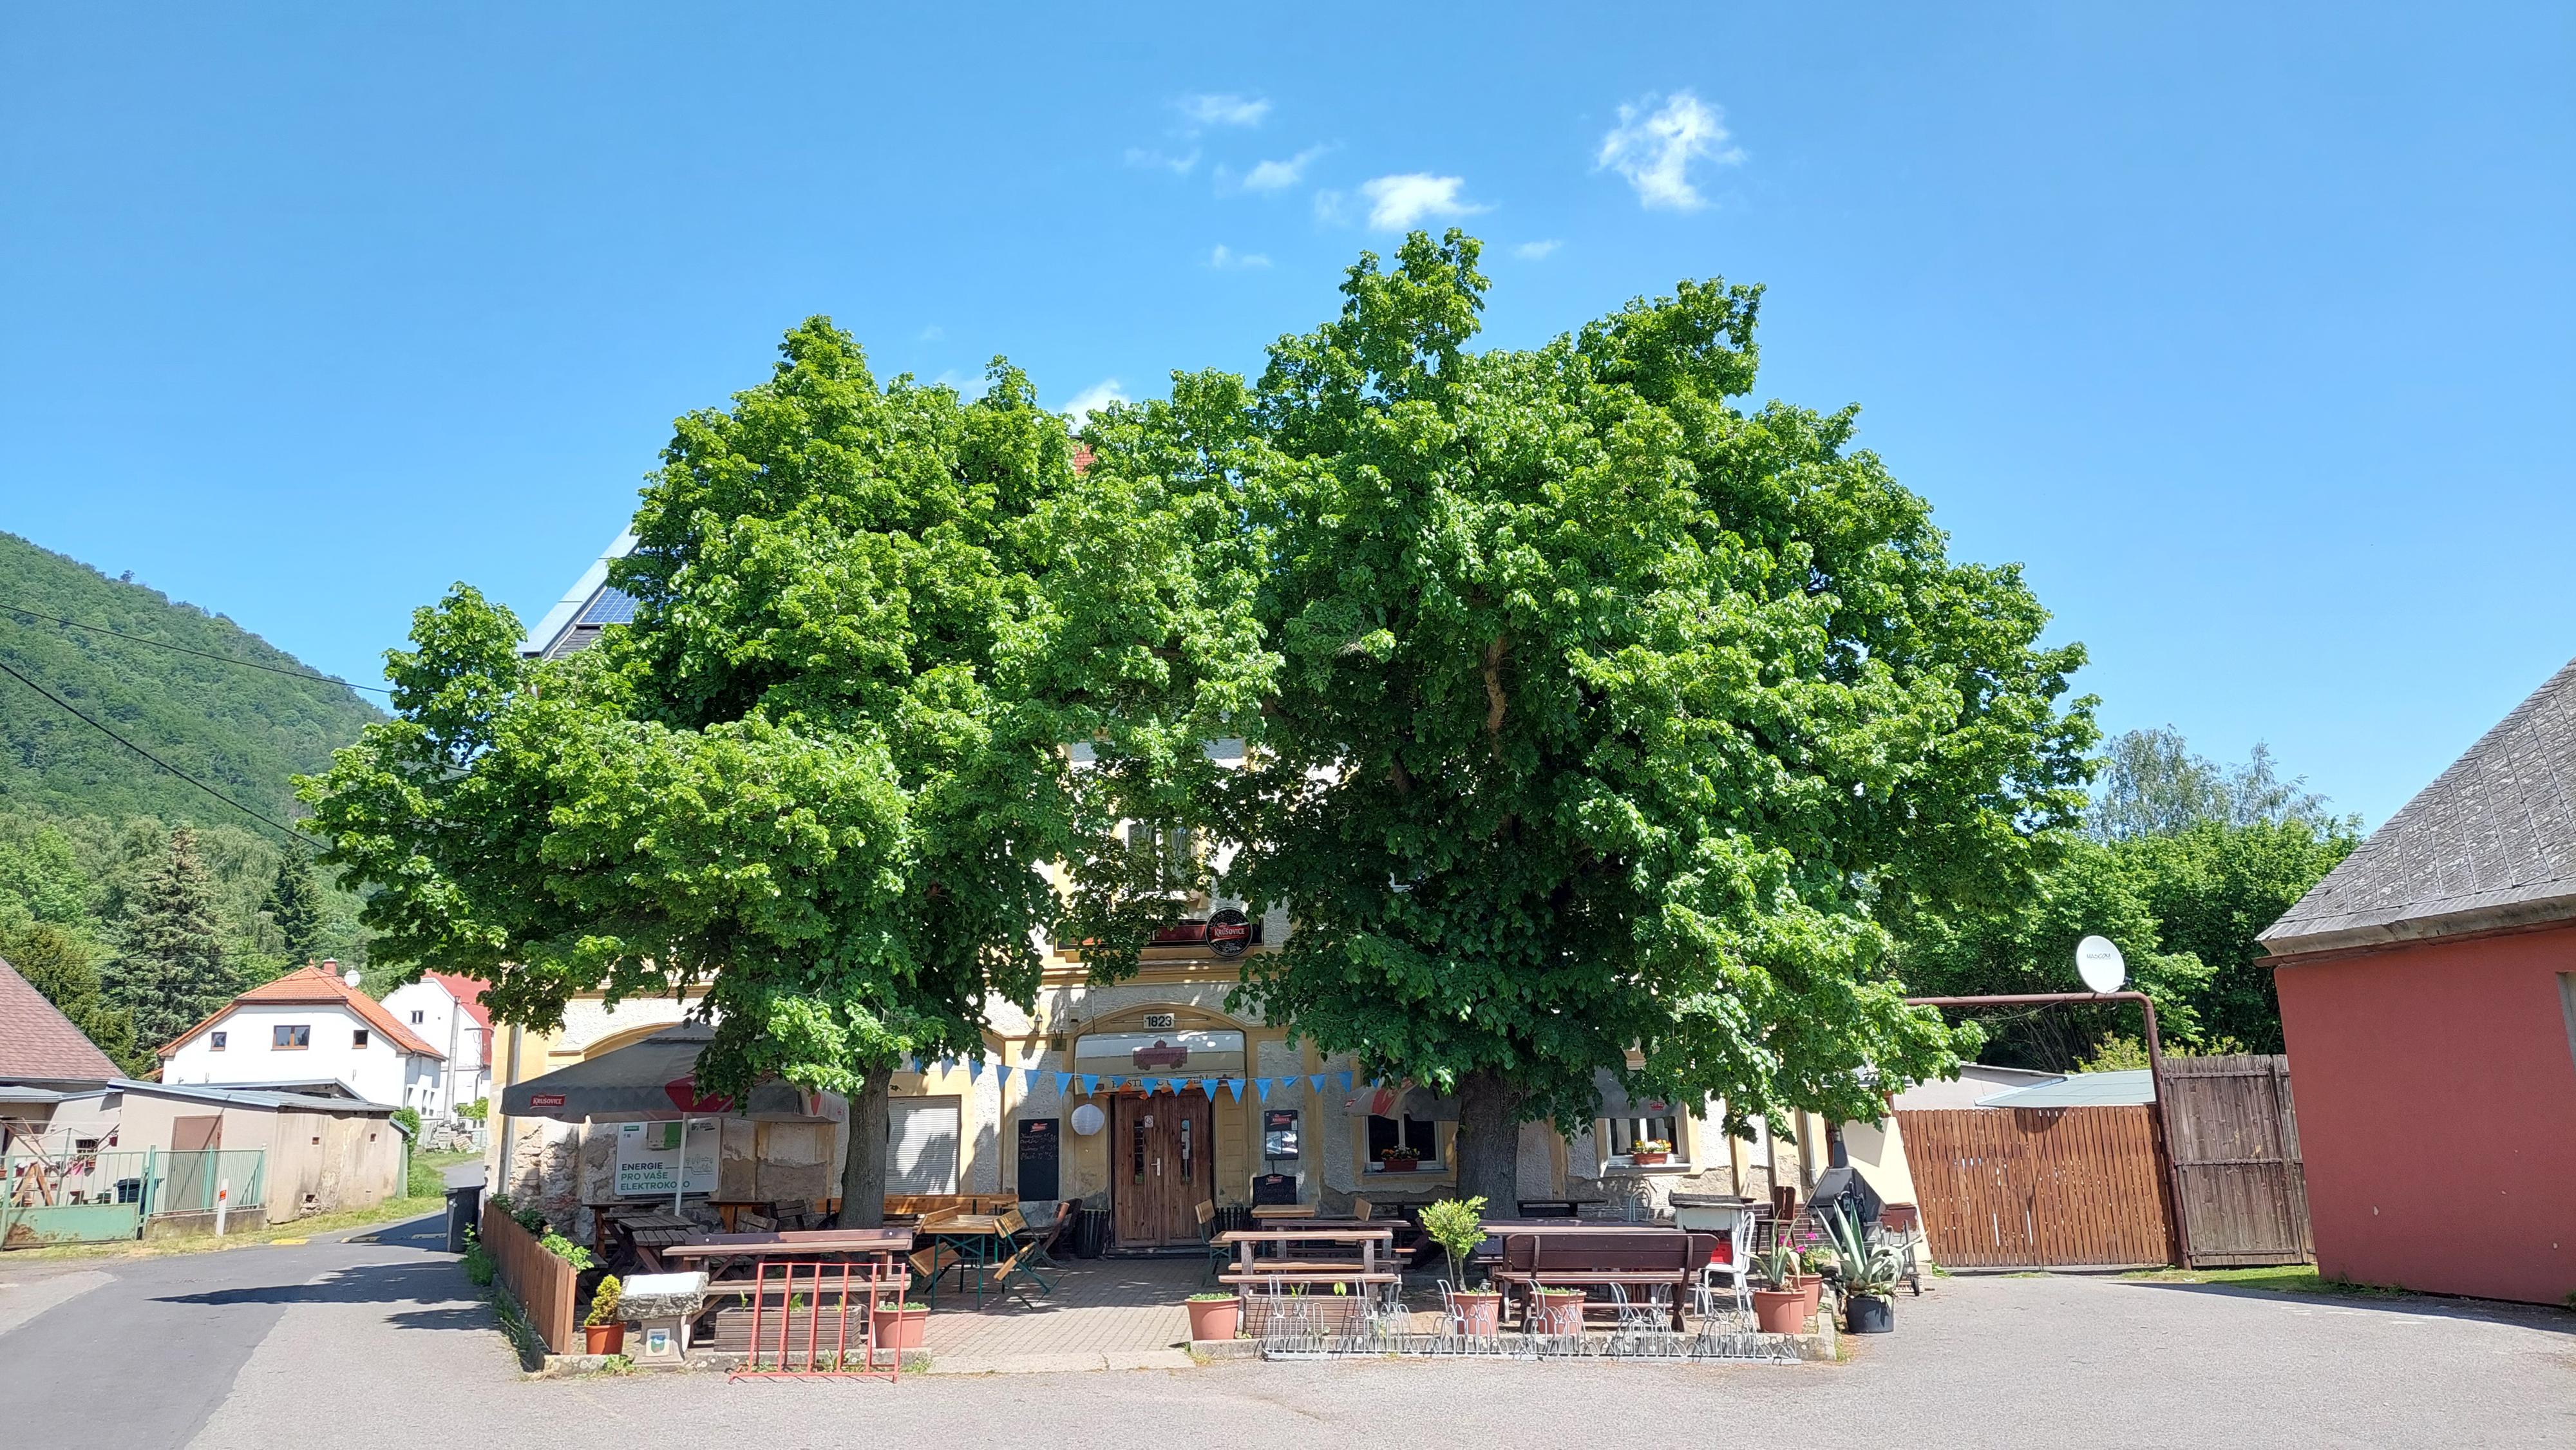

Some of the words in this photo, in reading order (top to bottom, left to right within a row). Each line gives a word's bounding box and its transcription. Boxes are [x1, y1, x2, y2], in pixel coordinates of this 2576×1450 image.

[1146, 1015, 1172, 1027] 1823
[621, 1162, 663, 1171] ENERGIE
[643, 1171, 668, 1180] VAŠE
[620, 1180, 690, 1191] ELEKTROKOO
